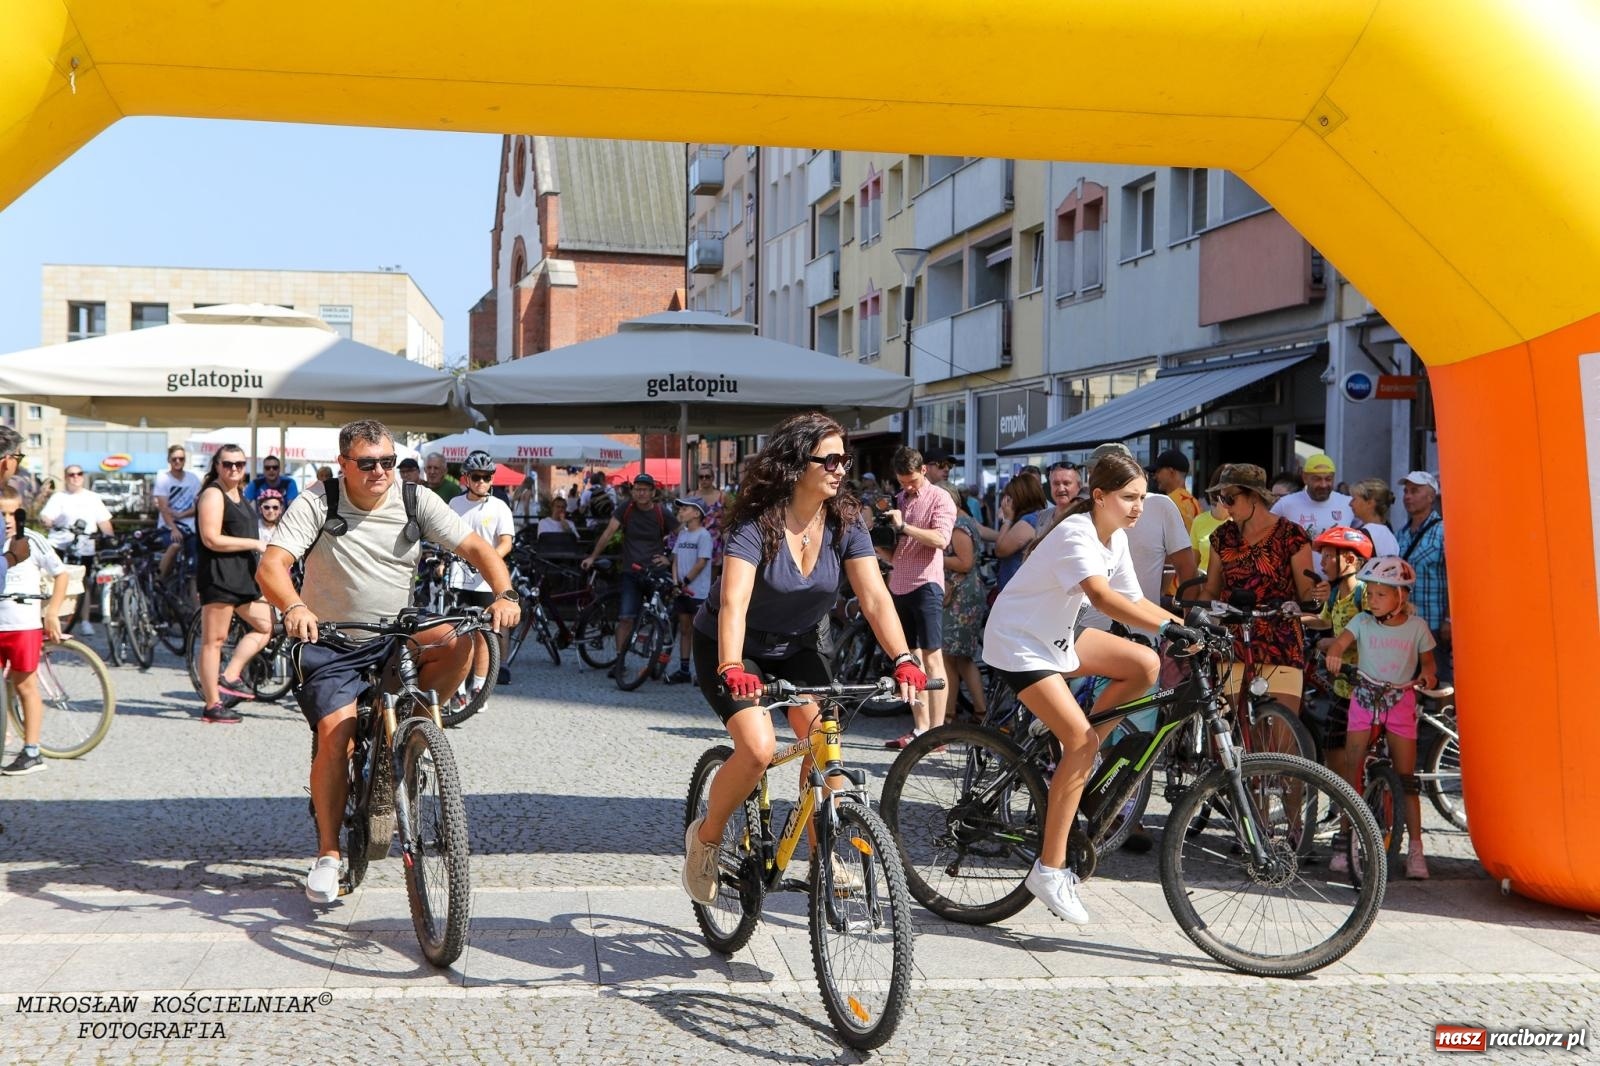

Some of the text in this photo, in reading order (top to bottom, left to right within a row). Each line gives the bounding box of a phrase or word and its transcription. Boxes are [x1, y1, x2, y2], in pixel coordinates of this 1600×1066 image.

[167, 368, 263, 392] gelatopiu
[647, 373, 738, 397] gelatopiu
[1000, 404, 1026, 439] empik
[517, 445, 554, 457] ŻYWIEC
[600, 448, 622, 459] ŻYWIEC
